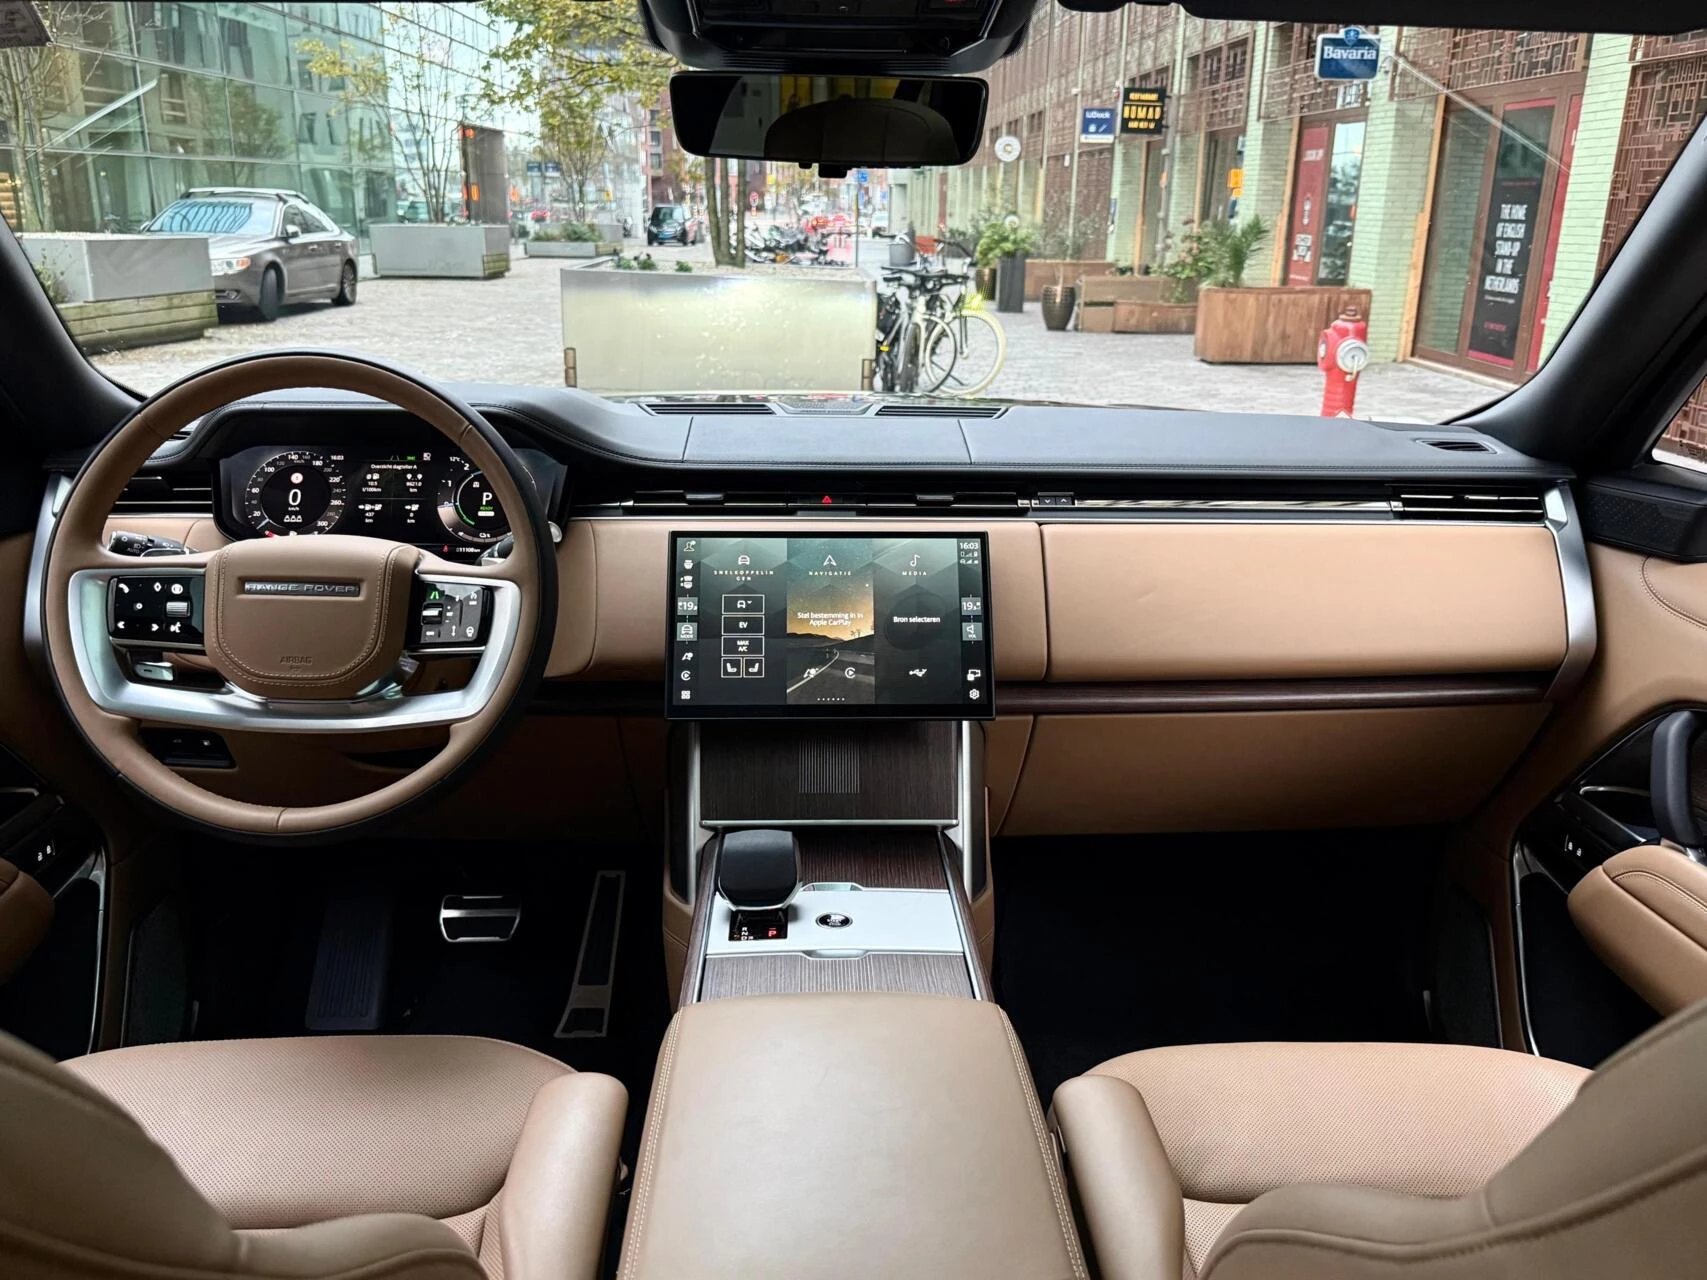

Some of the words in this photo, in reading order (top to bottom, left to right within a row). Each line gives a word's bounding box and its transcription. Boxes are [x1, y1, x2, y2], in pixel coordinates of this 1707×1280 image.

[1323, 46, 1376, 60] Bavaria
[1123, 106, 1161, 120] NOMAD
[1500, 204, 1512, 220] THE
[1510, 204, 1528, 220] HOME
[1496, 222, 1504, 238] OF
[1503, 222, 1526, 238] ENGLISH
[1502, 258, 1514, 274] THE
[1484, 275, 1520, 294] NETHERLANDS
[288, 488, 302, 506] 0
[482, 492, 492, 505] P
[960, 542, 979, 550] 16:03
[246, 583, 300, 592] RANGE
[303, 584, 356, 593] ROVER
[810, 612, 849, 620] bestemming
[280, 656, 313, 665] AIRBAG
